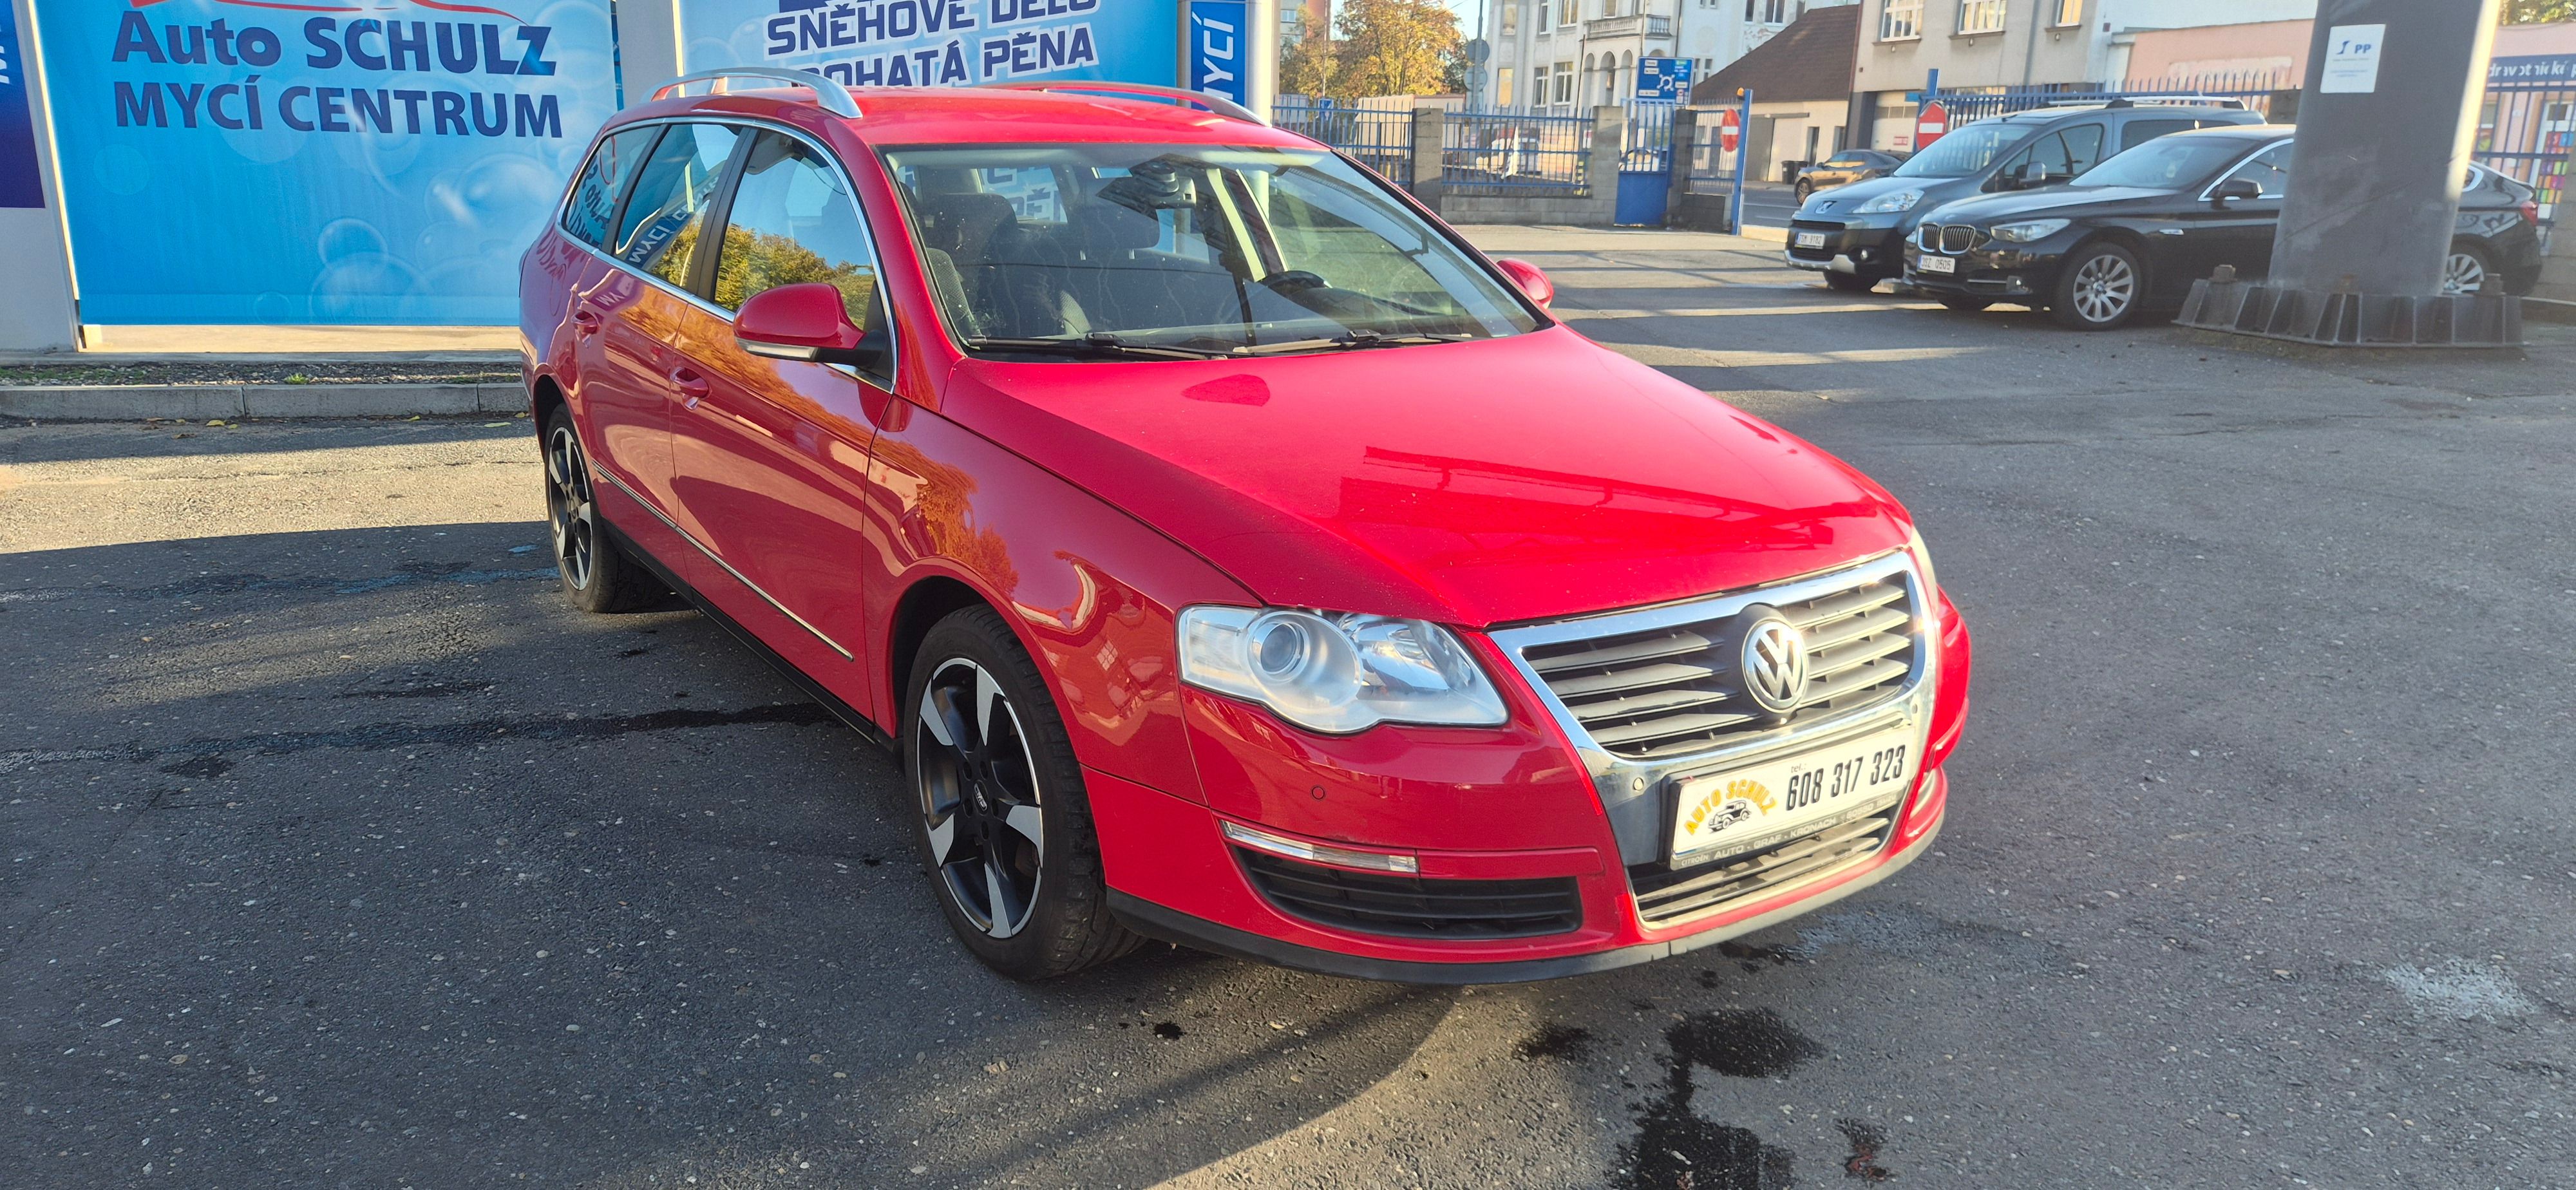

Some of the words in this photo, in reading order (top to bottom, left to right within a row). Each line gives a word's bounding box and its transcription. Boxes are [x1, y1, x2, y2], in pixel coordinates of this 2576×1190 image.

[111, 10, 281, 66] Auto
[304, 17, 557, 76] SCHULZ
[799, 41, 967, 86] OHATÁ
[984, 27, 1094, 77] PĚNA
[2354, 44, 2371, 54] PP
[113, 75, 263, 130] MYCÍ
[278, 86, 562, 138] CENTRUM
[1786, 768, 1824, 811] 608
[1830, 756, 1864, 798] 317
[1870, 744, 1906, 786] 323
[1684, 789, 1722, 836] AUTO
[1726, 779, 1777, 817] SCHULZ
[1714, 845, 1744, 860] AUTO
[1754, 834, 1782, 849] GRAF
[1790, 817, 1836, 838] KRONACH
